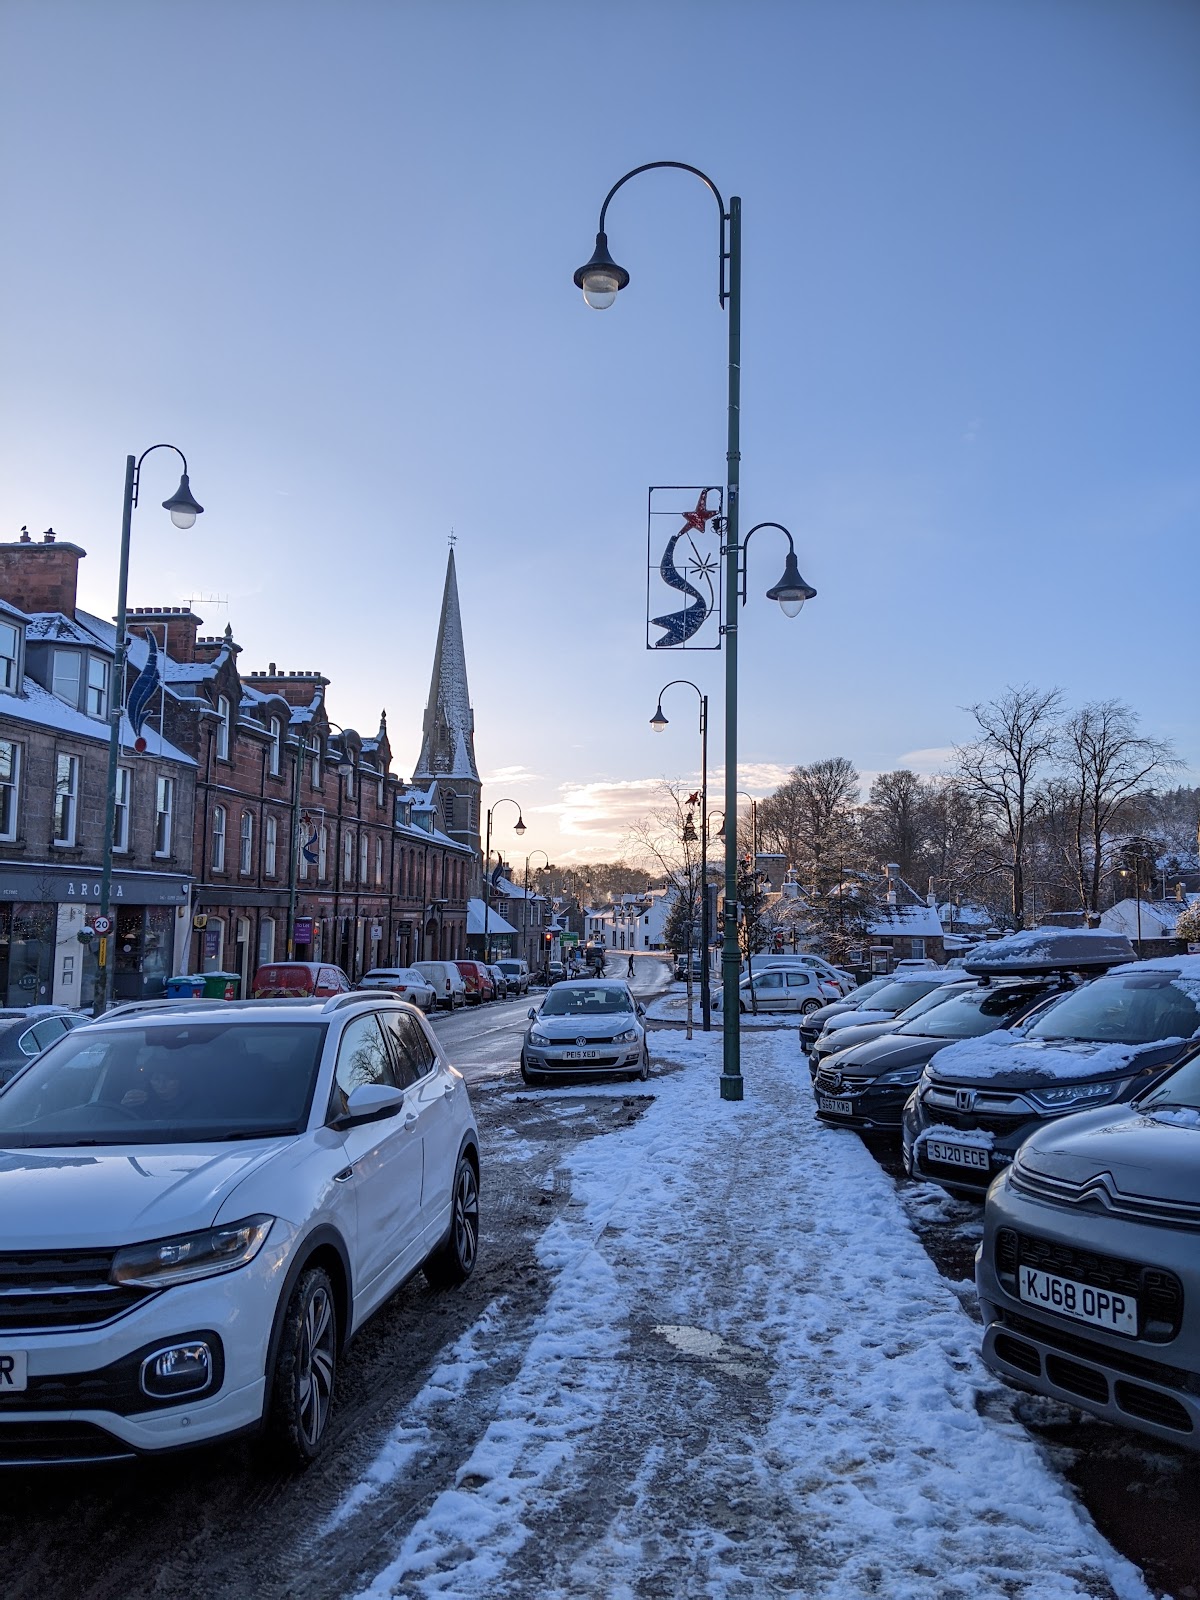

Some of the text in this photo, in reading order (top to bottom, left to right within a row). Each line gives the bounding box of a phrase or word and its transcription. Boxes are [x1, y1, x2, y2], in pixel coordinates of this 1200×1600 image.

[68, 883, 123, 897] AROA
[96, 921, 108, 929] 20
[582, 1050, 596, 1058] XED
[934, 1144, 987, 1167] SJ20 ECE
[1027, 1270, 1126, 1324] KJ68 OPP
